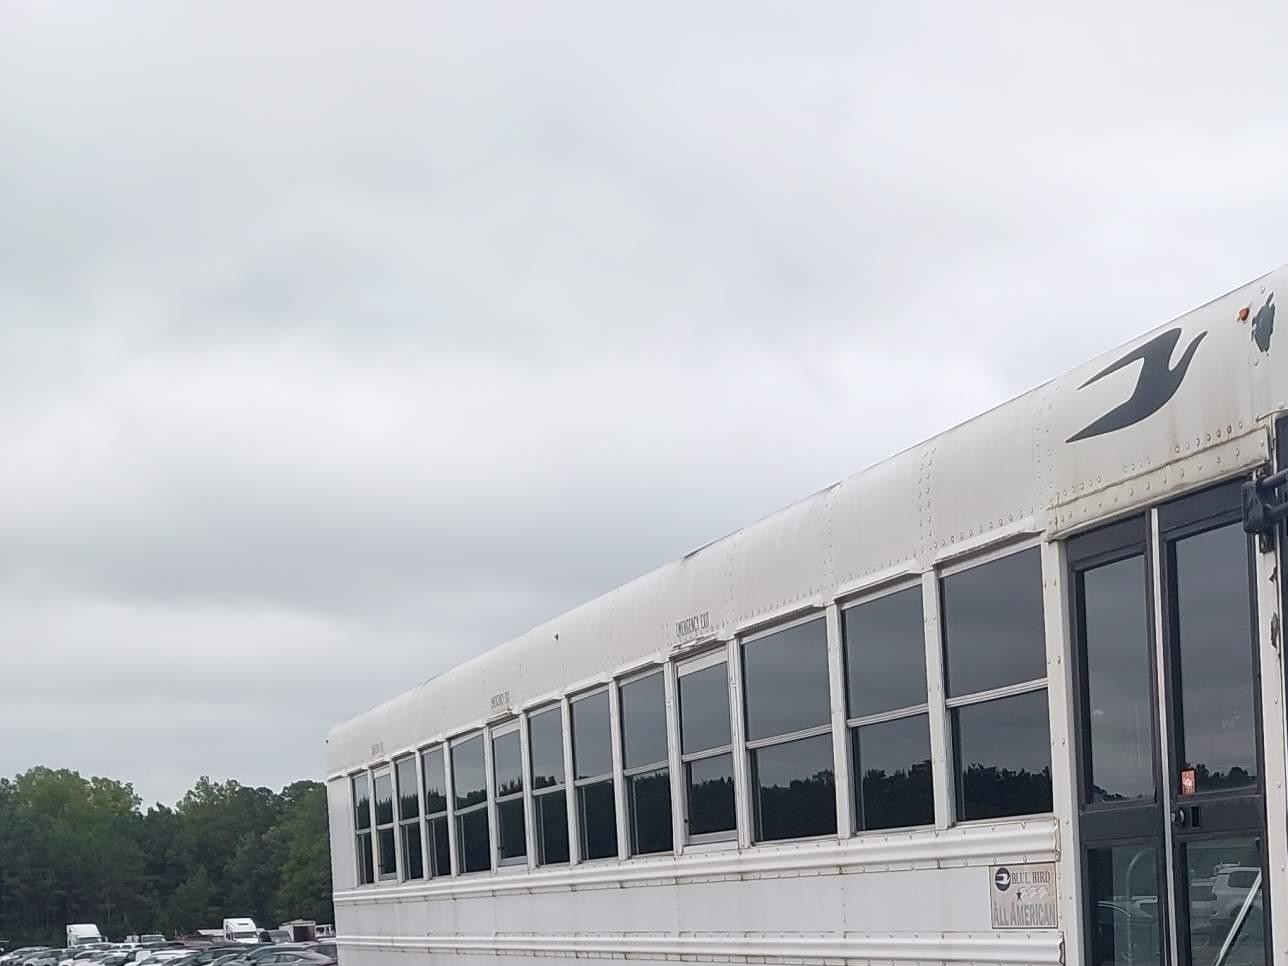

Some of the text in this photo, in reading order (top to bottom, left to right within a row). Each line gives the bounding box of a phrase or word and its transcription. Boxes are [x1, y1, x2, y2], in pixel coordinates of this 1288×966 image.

[1011, 870, 1051, 885] BLUE BIRD
[1010, 901, 1056, 926] AMERICAN
